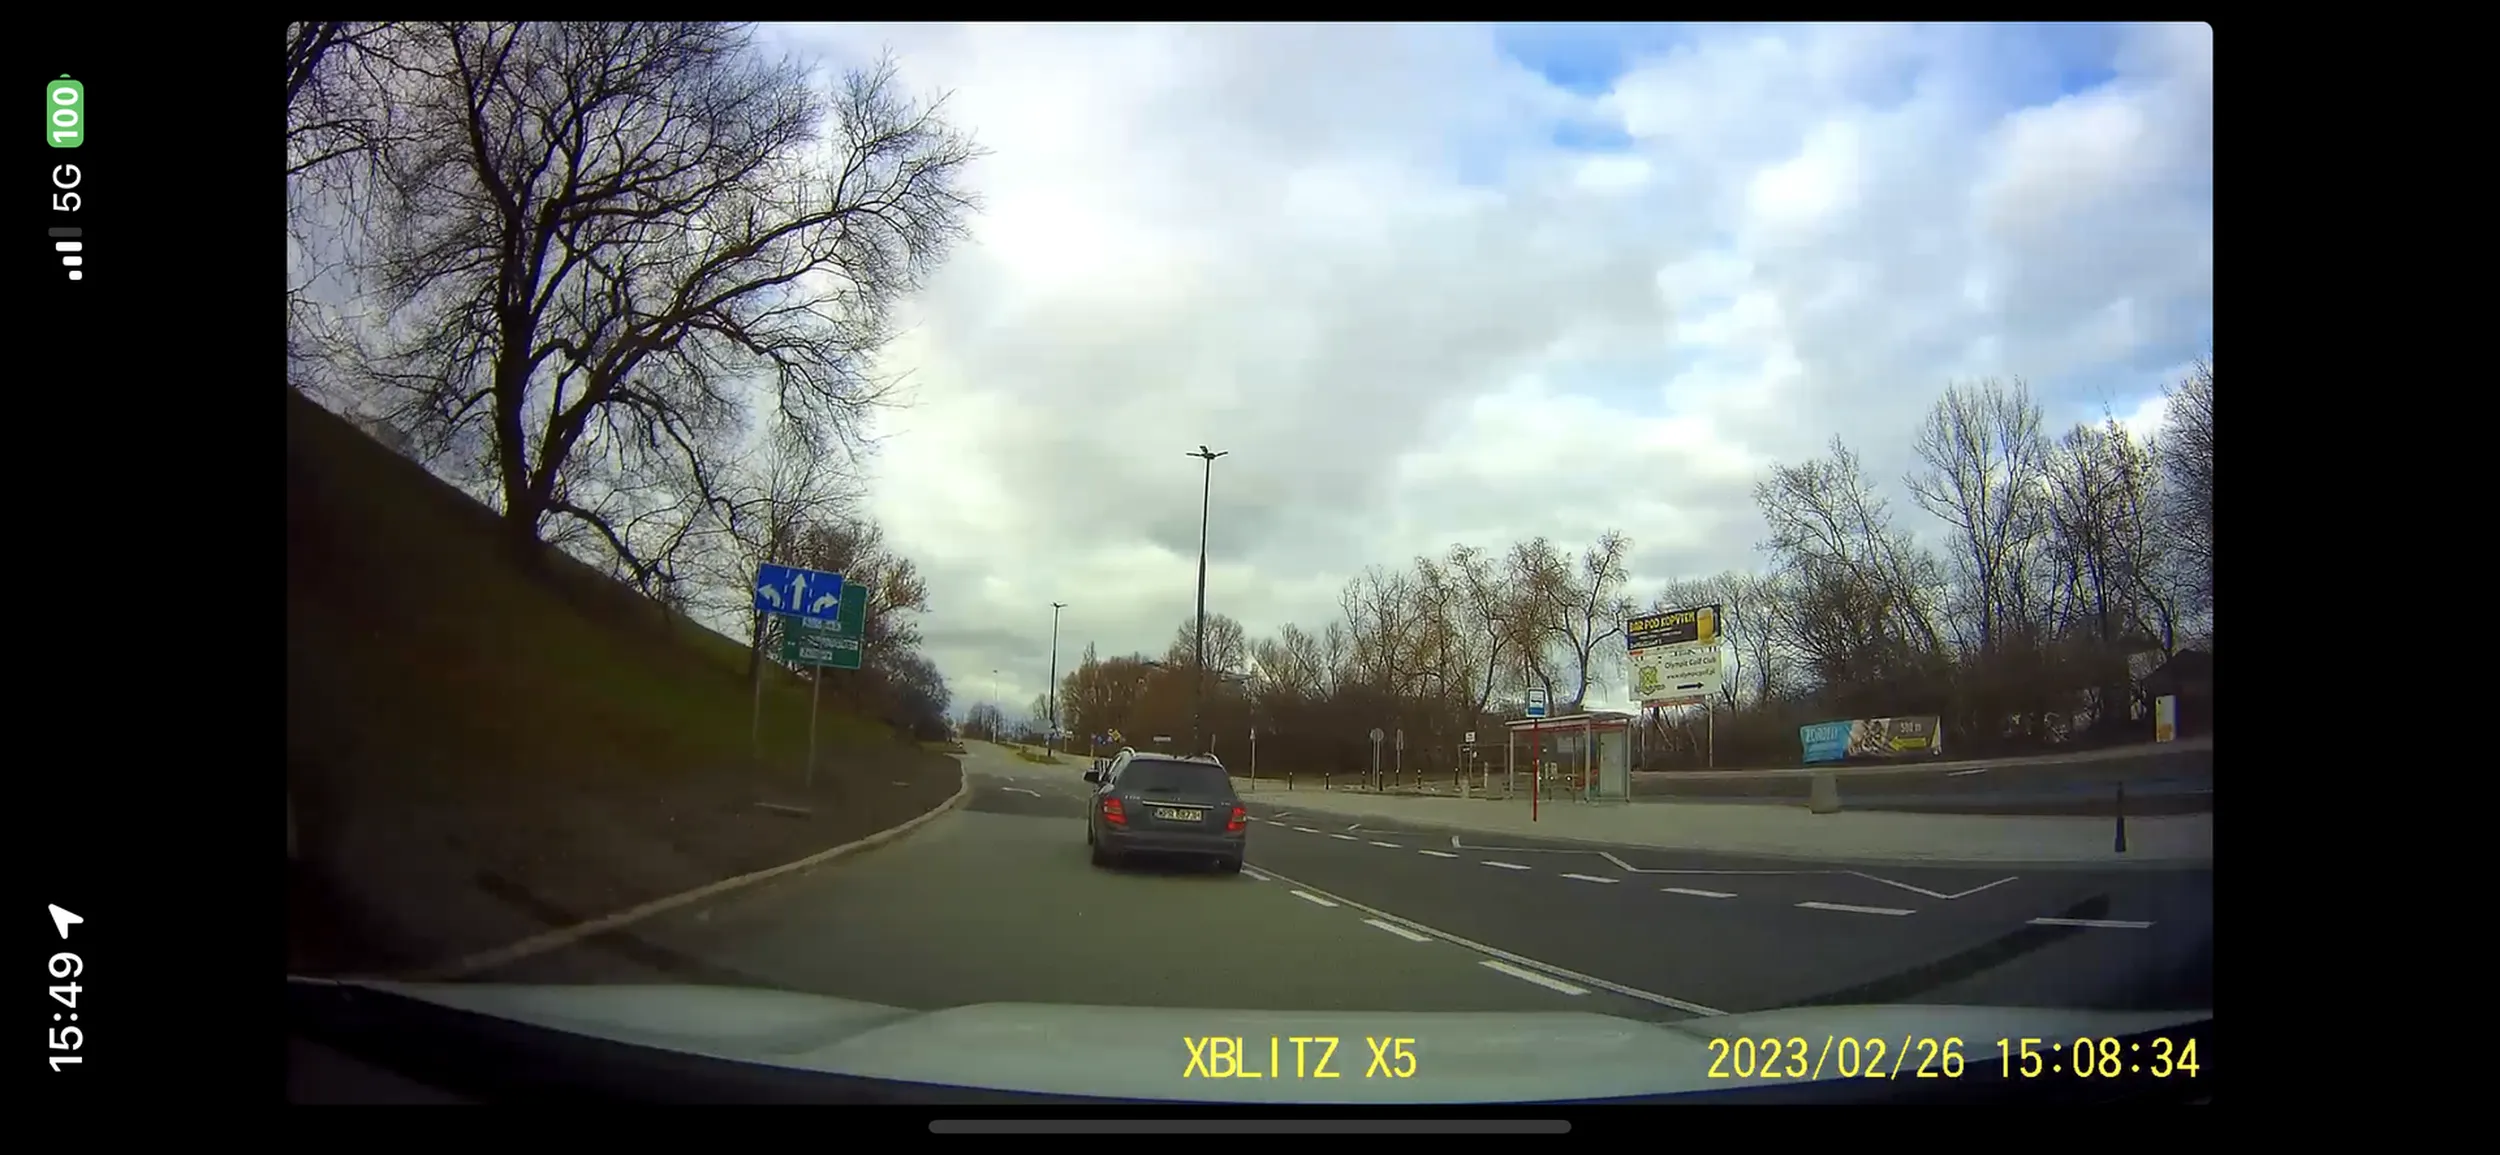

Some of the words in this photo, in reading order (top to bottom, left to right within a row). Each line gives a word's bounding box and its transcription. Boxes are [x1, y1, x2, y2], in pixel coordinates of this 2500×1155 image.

[1644, 617, 1660, 629] POD
[1689, 657, 1702, 666] Golf
[1703, 655, 1716, 664] Club
